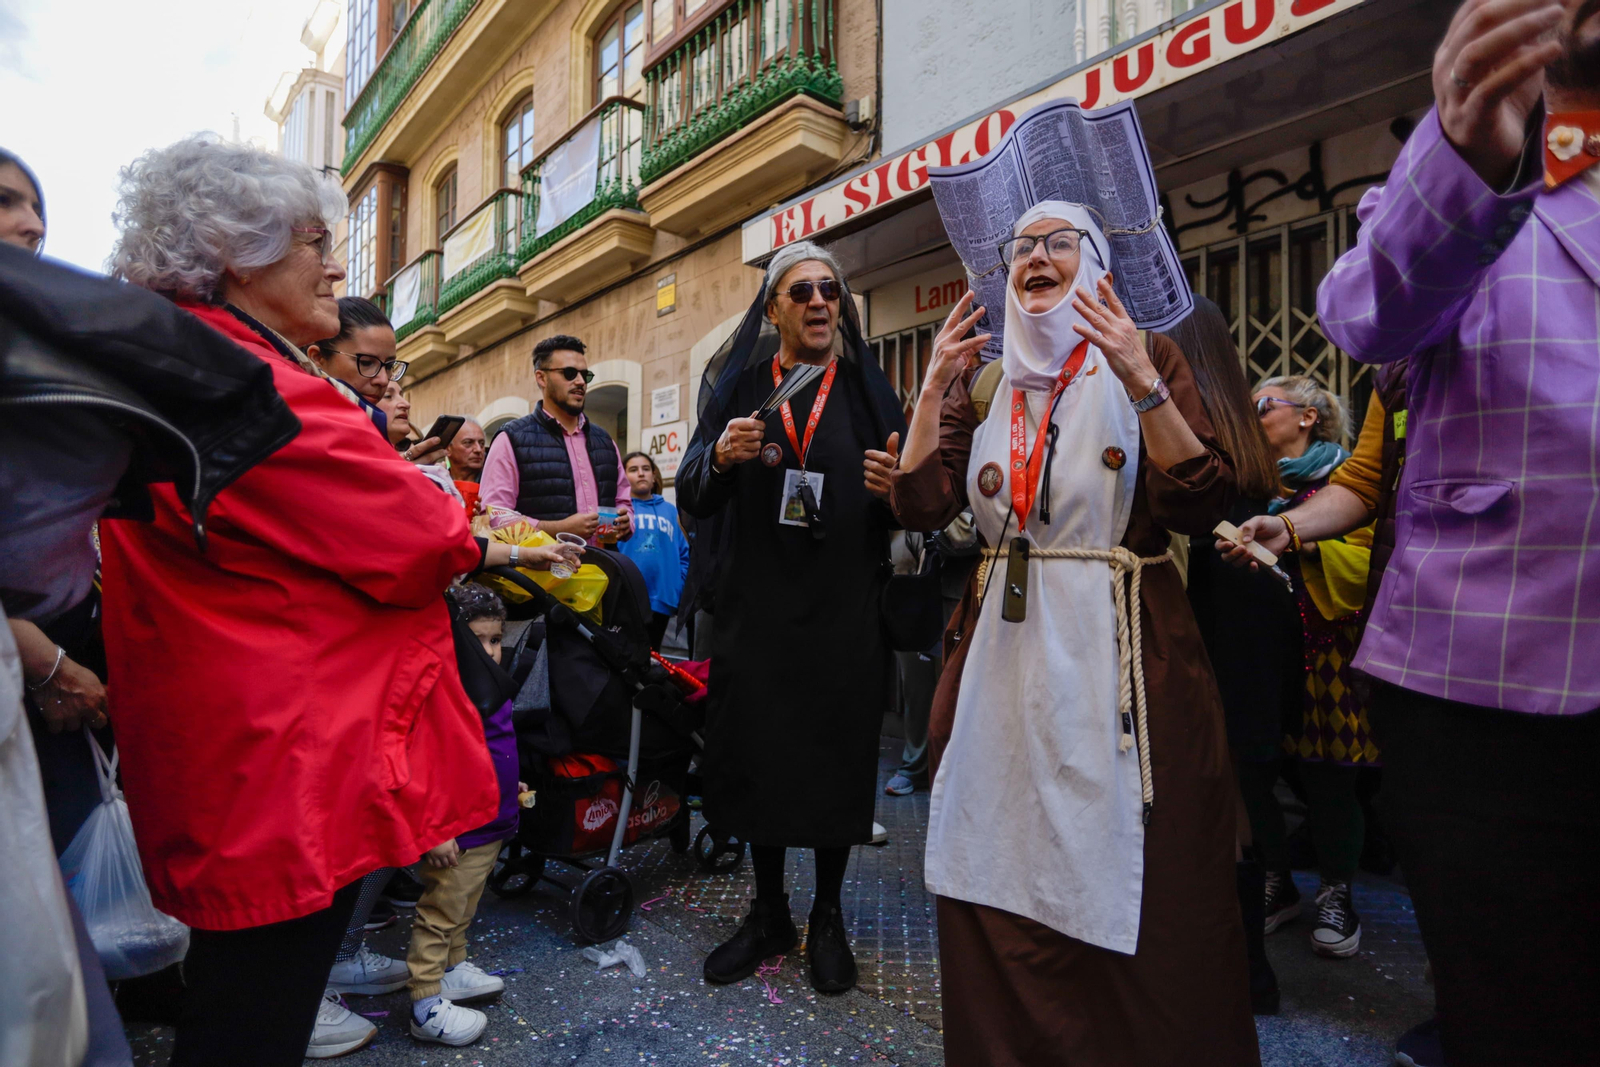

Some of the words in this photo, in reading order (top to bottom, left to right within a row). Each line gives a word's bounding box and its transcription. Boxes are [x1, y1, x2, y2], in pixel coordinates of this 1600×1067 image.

[771, 197, 826, 249] EL
[843, 109, 1016, 219] SIGLO
[915, 278, 968, 313] Lam
[634, 513, 674, 542] ITCH
